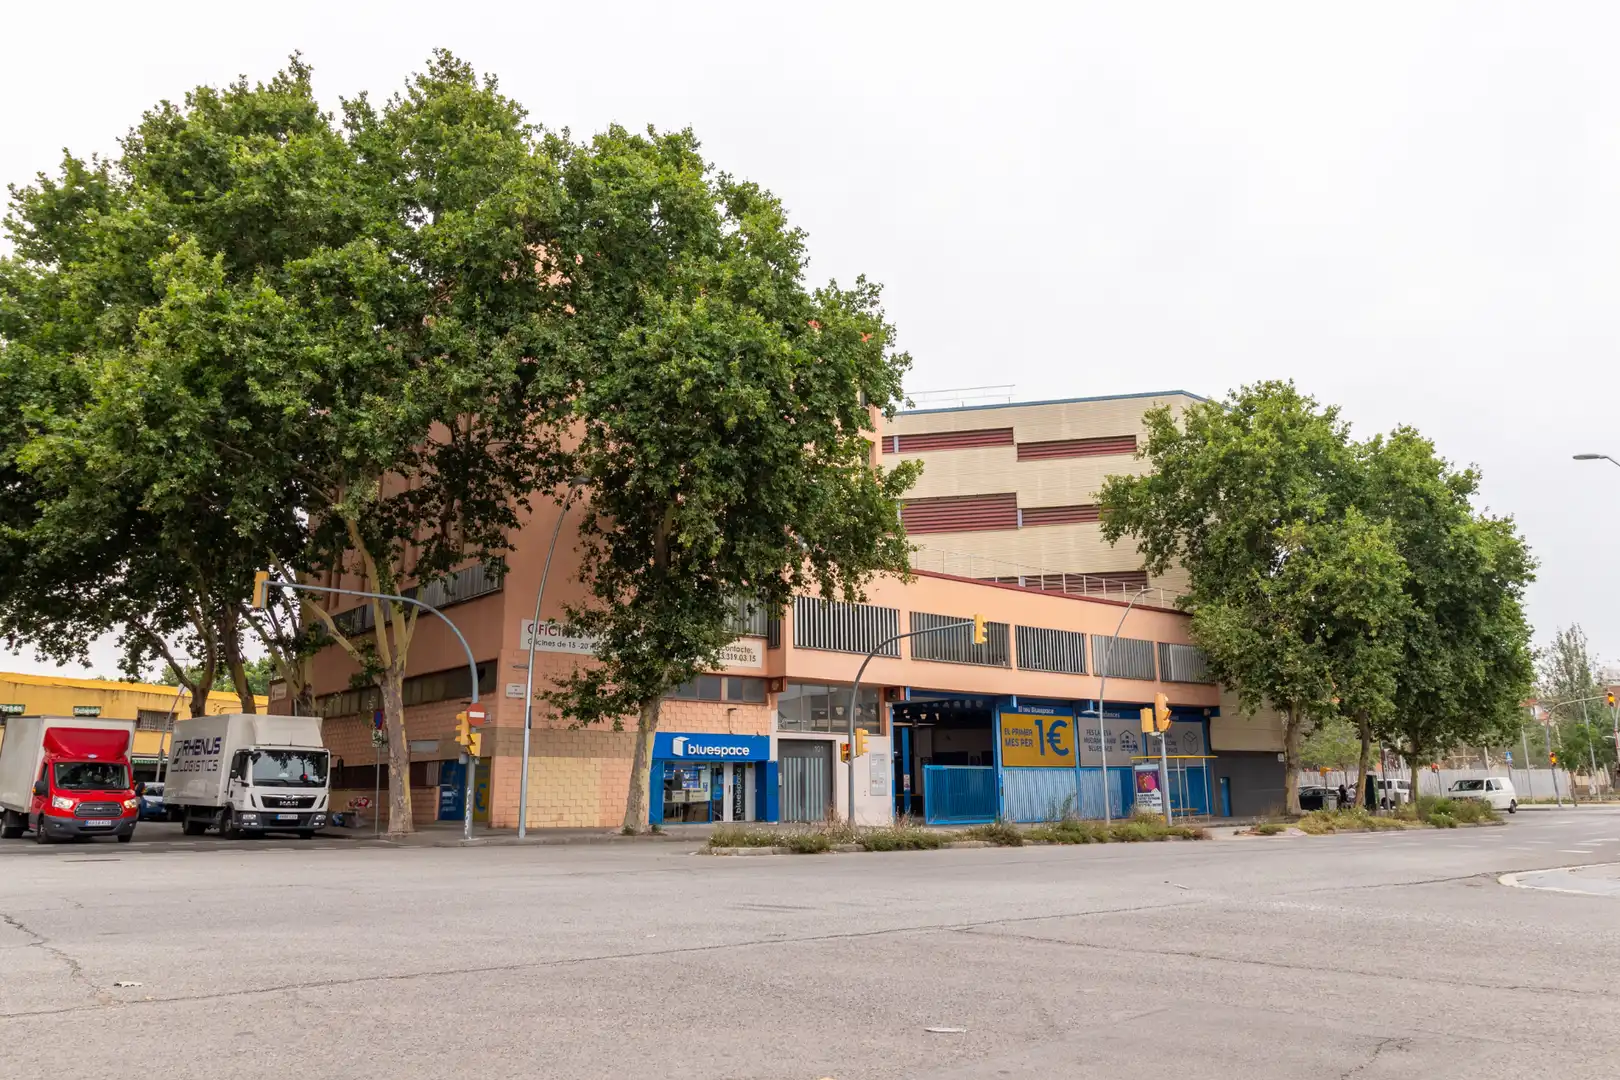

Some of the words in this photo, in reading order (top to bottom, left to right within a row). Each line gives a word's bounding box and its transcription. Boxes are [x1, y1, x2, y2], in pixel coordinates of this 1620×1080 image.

[527, 623, 582, 639] OFICI
[527, 639, 555, 648] Oicines
[720, 645, 754, 654] ontacte:
[182, 736, 222, 756] RHENUS
[687, 744, 750, 757] bluespace
[180, 759, 219, 773] LOGISTICS
